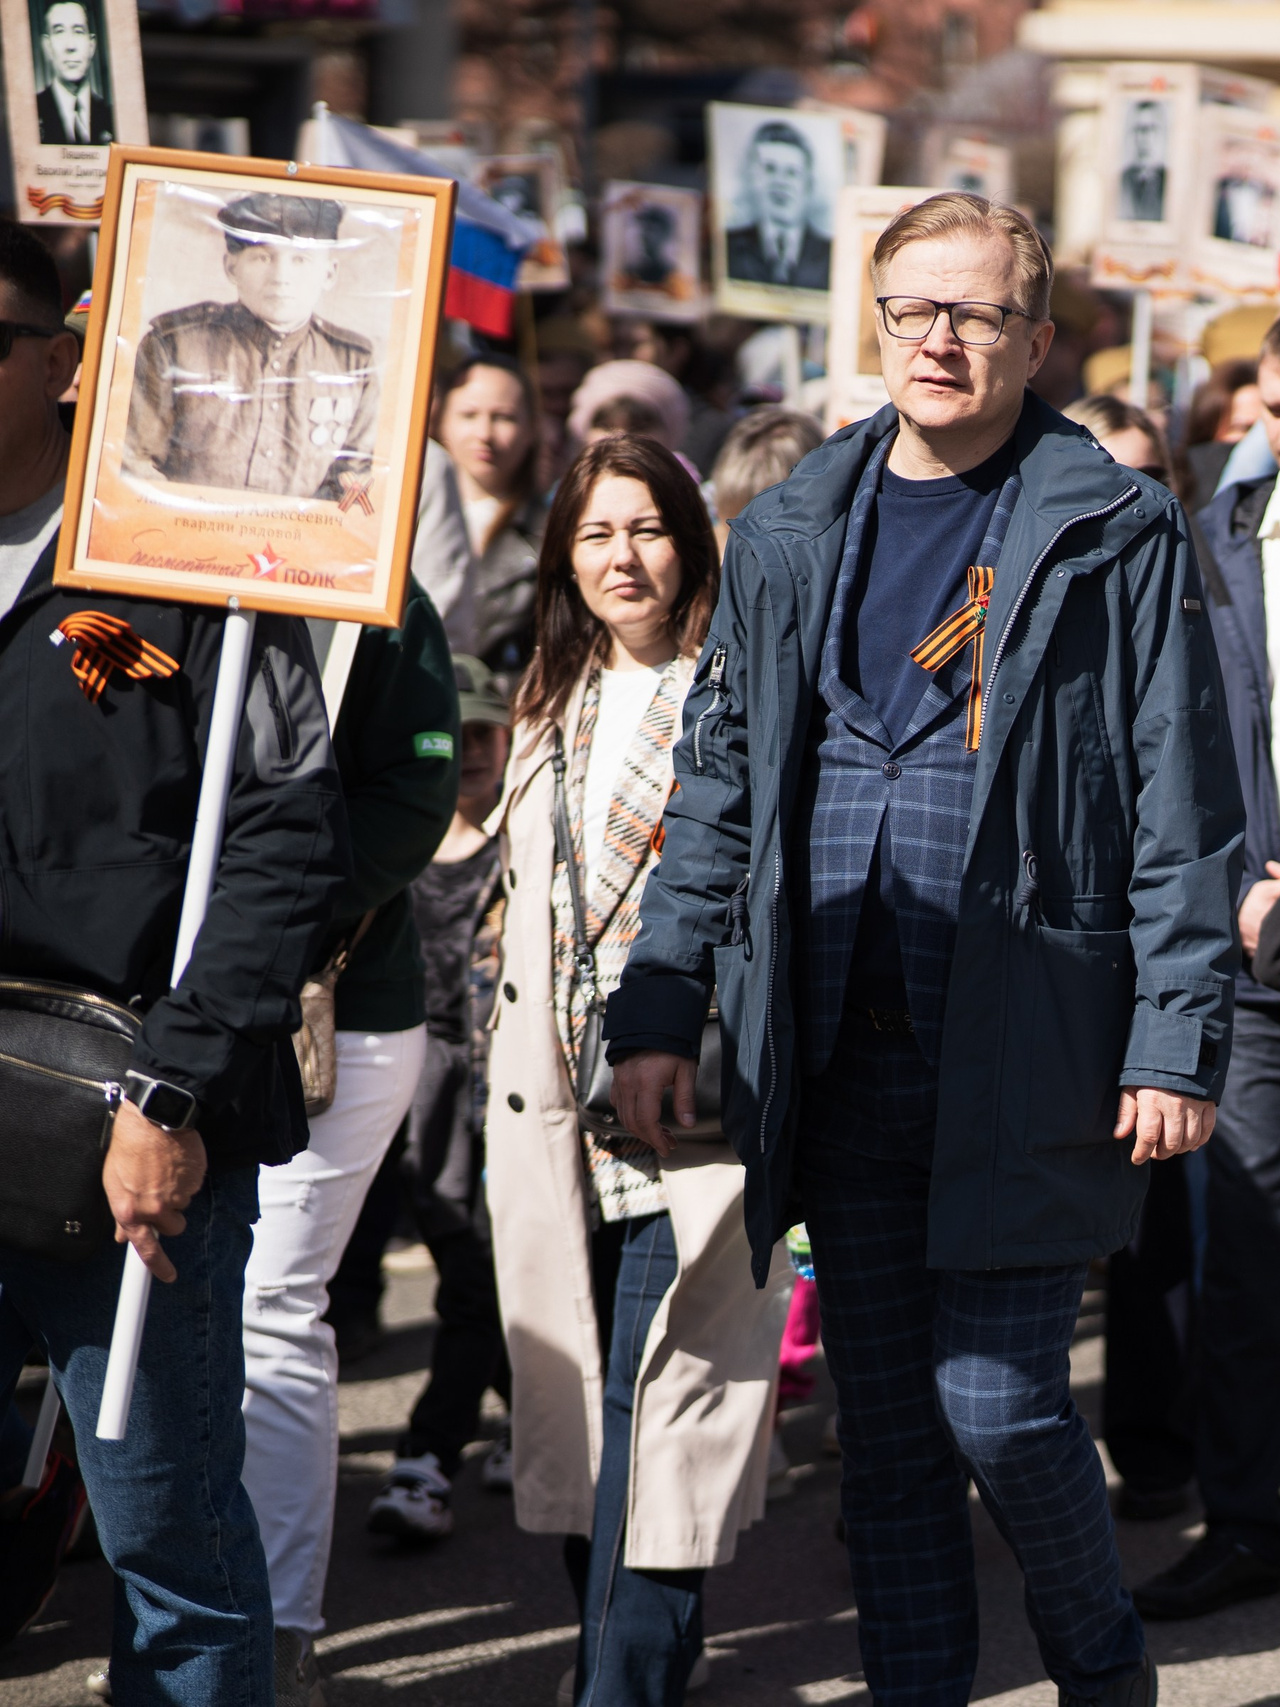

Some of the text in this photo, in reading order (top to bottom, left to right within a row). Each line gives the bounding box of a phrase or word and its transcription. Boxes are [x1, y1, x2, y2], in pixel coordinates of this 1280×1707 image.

[75, 165, 107, 178] Дмитри
[173, 516, 302, 541] гвардии рядовой
[251, 508, 344, 528] Алексеевич
[284, 567, 337, 589] ПОЛК
